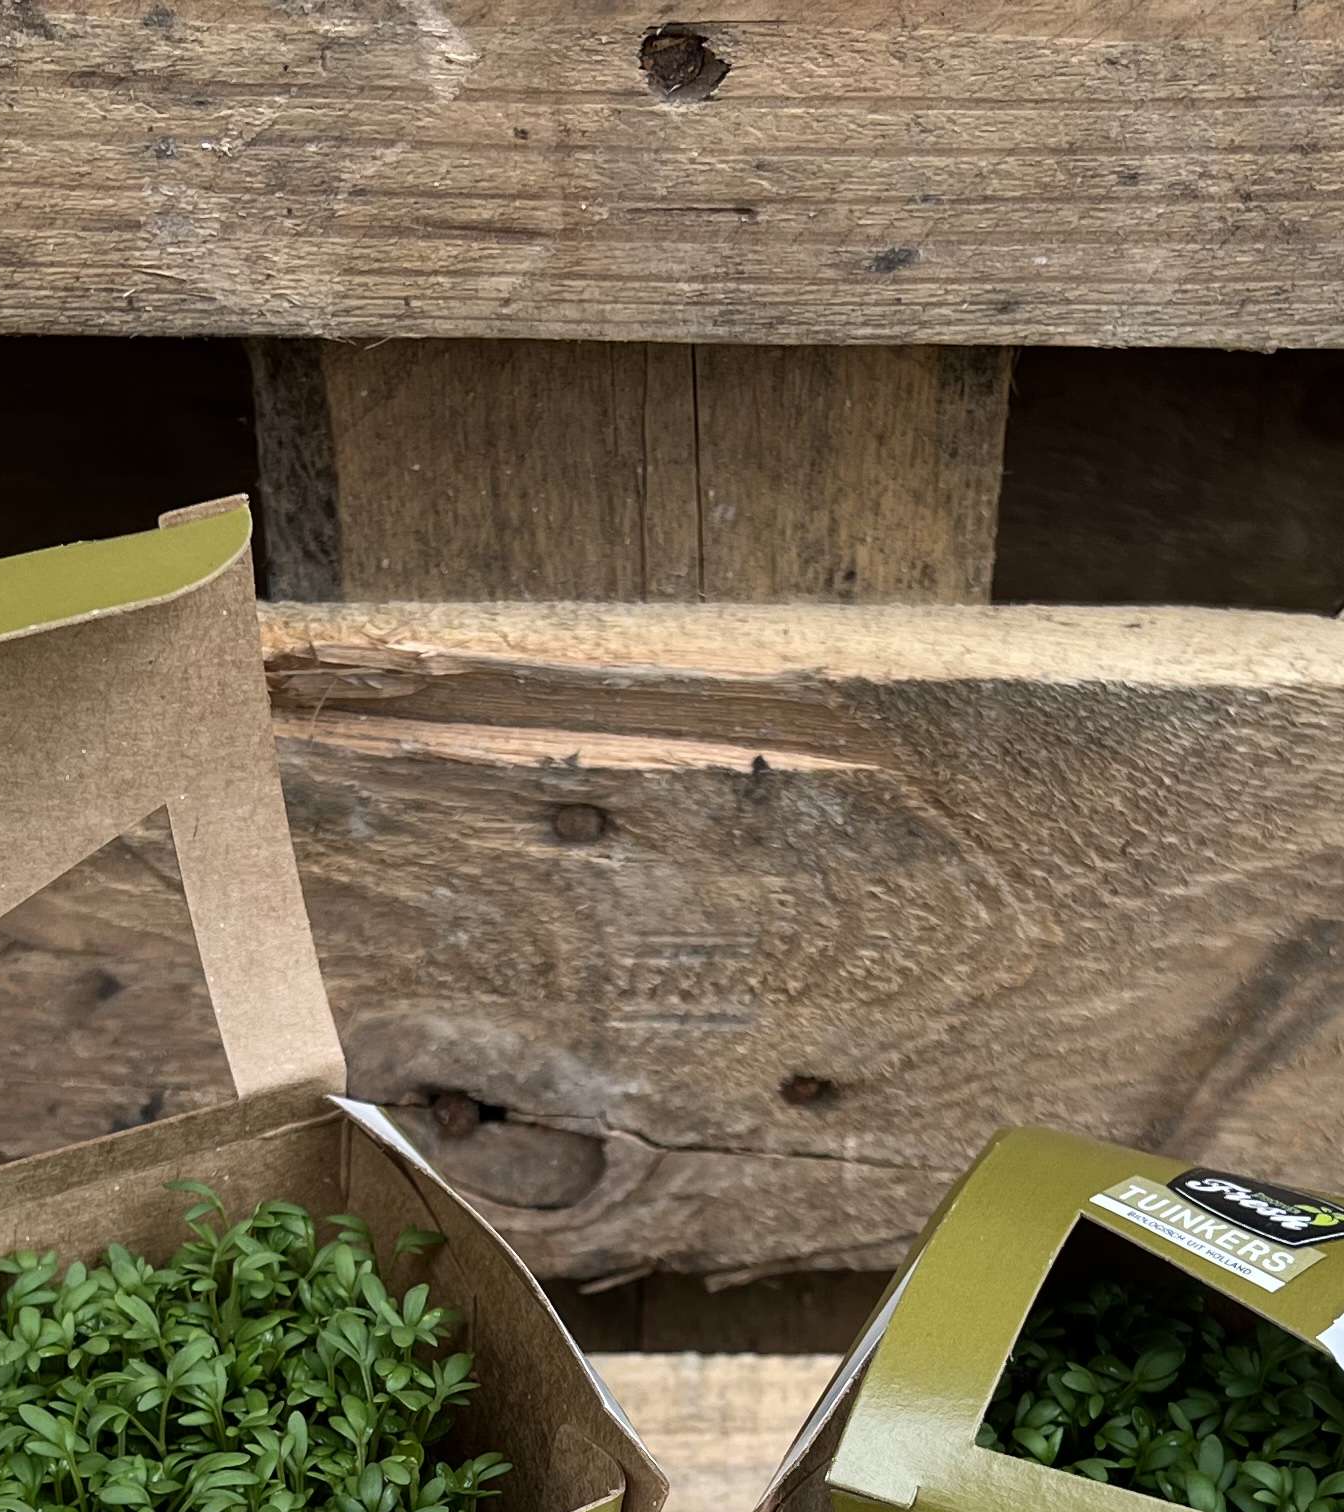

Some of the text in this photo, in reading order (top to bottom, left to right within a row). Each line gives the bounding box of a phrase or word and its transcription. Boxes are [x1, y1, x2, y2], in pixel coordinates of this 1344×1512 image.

[1119, 1184, 1297, 1273] TUINKERS
[1185, 1178, 1312, 1231] Fresh
[1127, 1210, 1252, 1276] BIOLOGISCH UIT HOLLAND
